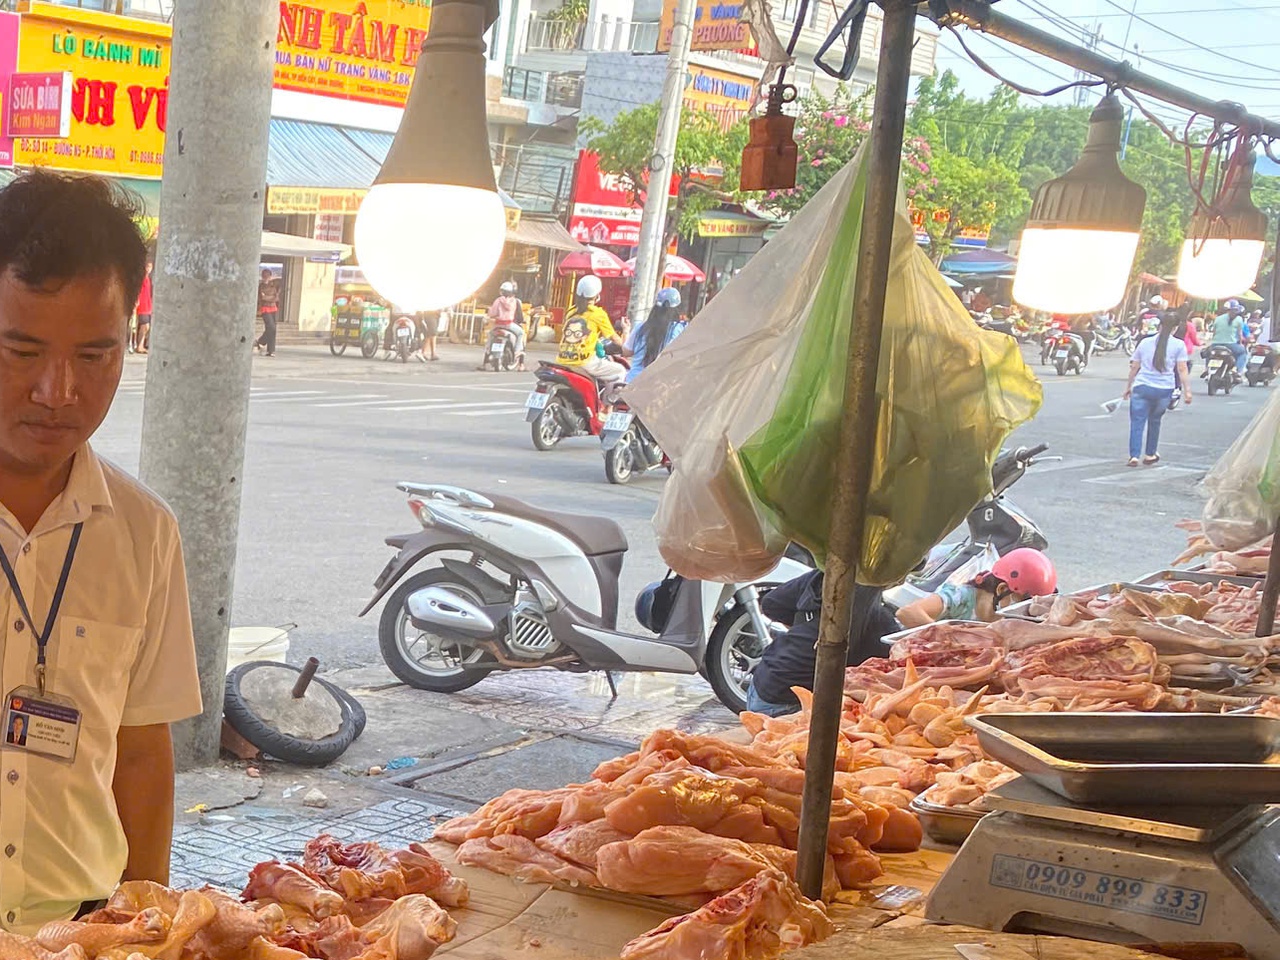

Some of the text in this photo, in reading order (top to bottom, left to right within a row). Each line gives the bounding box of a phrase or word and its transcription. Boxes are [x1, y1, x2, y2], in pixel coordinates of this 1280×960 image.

[52, 29, 162, 68] LÒ BÁNH MÌ
[328, 2, 399, 63] TÂM
[335, 61, 365, 79] TRANG
[368, 65, 391, 83] VÀNG
[1026, 863, 1202, 911] 0909 899 833
